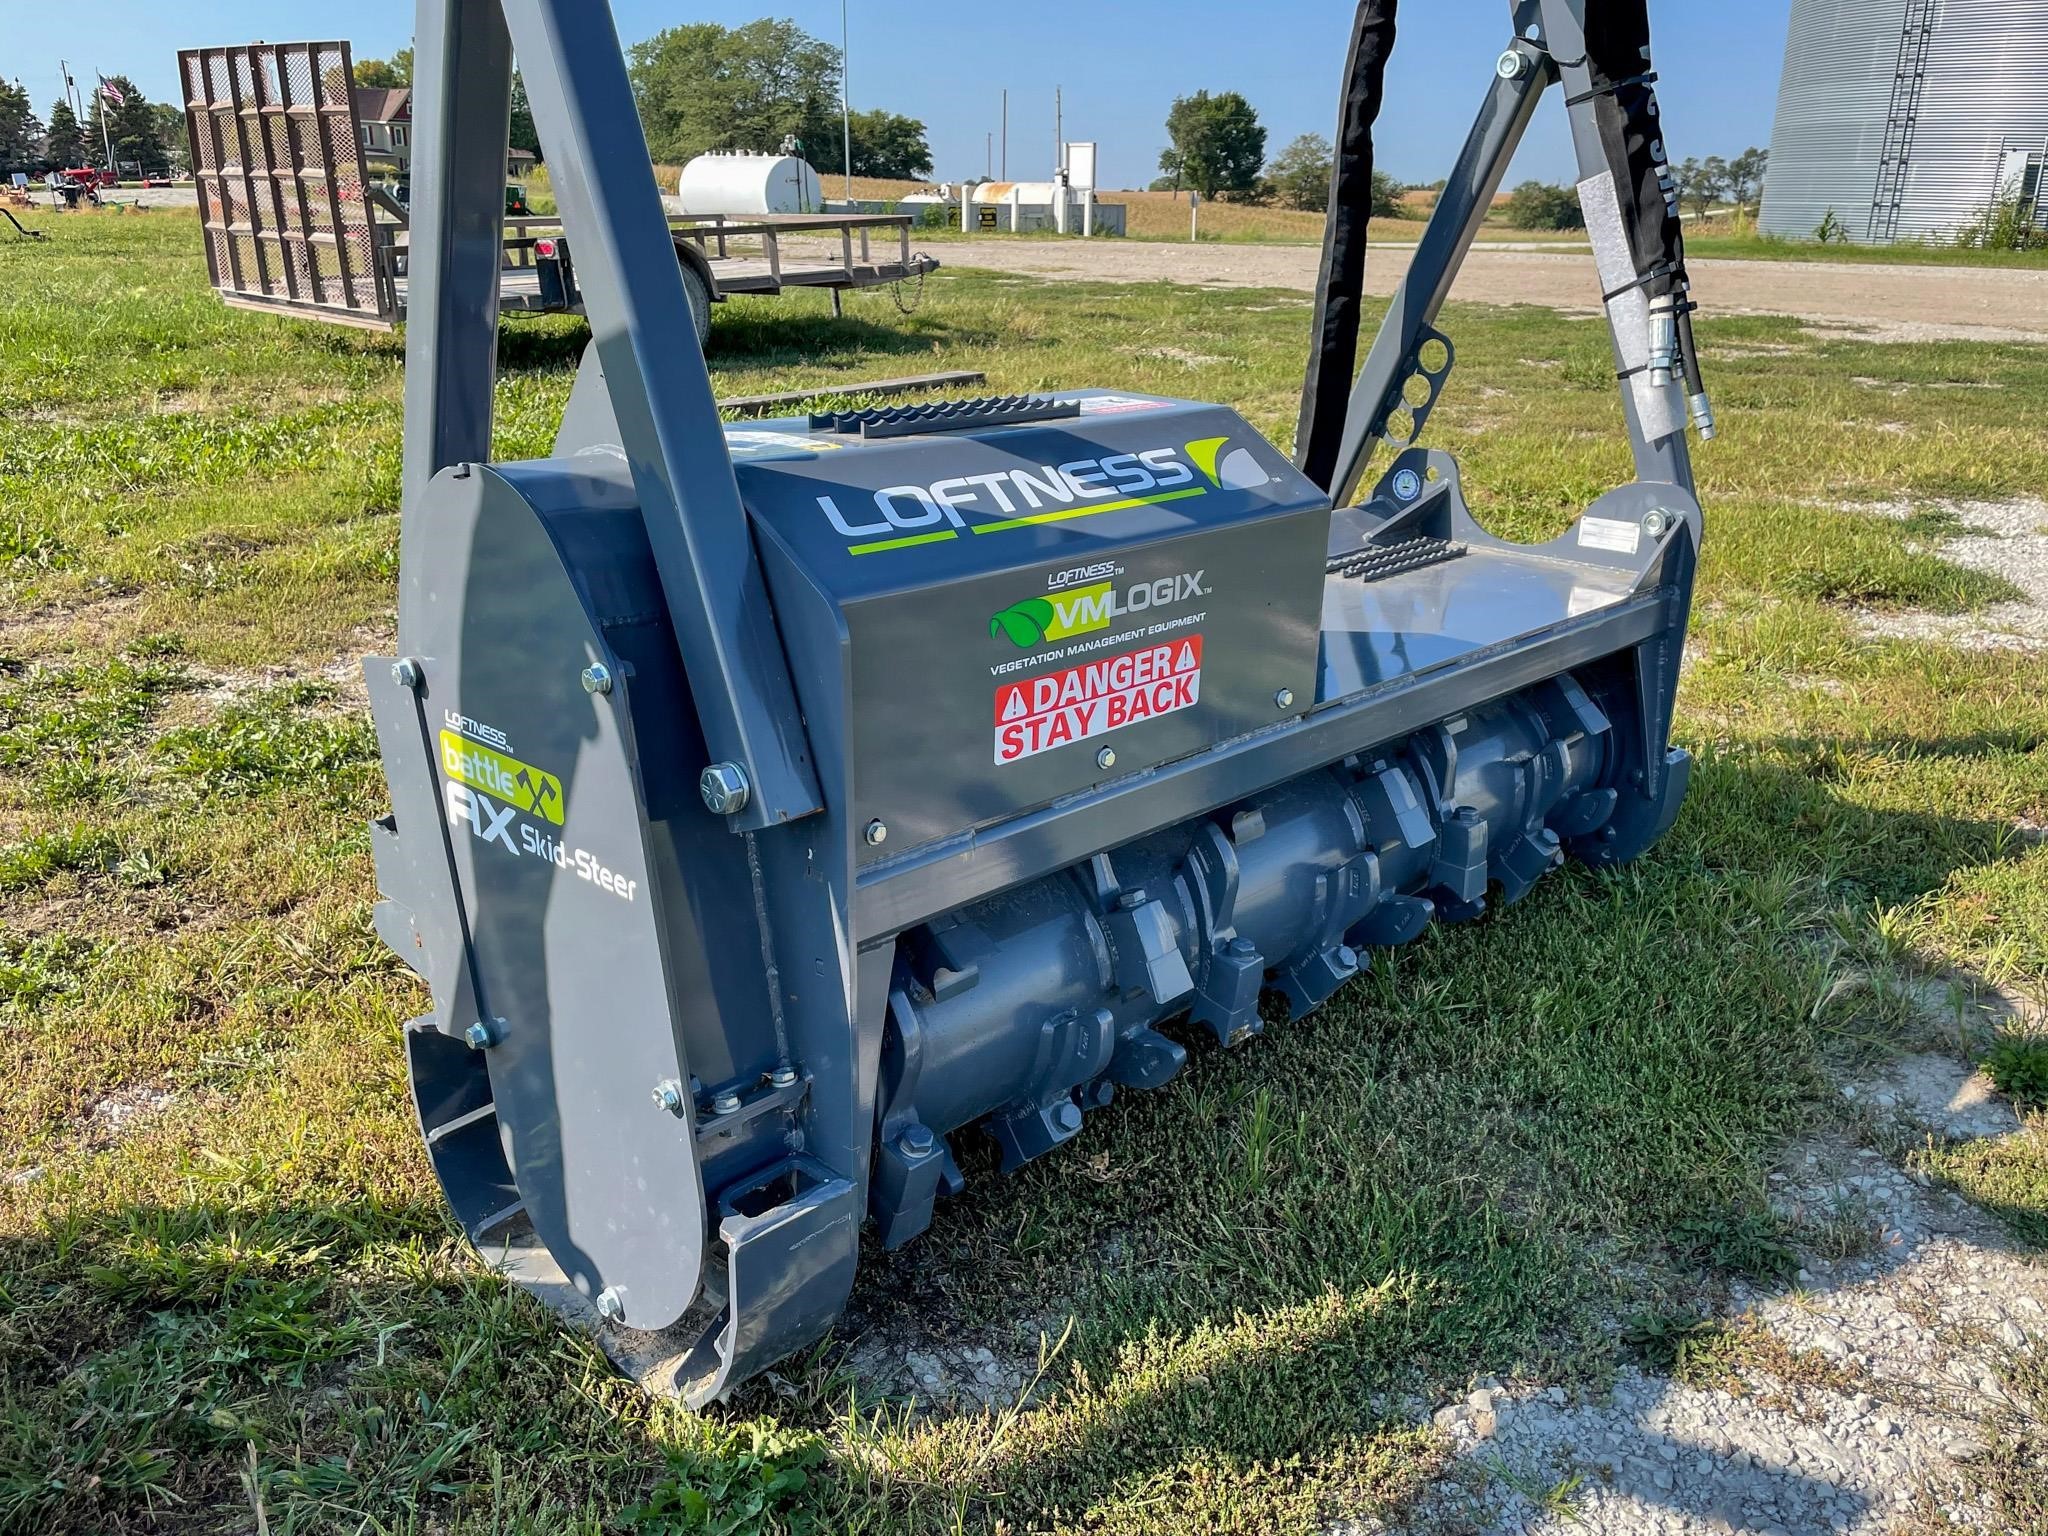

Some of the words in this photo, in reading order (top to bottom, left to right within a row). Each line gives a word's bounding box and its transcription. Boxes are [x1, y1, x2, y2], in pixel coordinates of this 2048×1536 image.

[816, 447, 1193, 537] LOFTNESS
[1048, 561, 1116, 586] LOFTNESS
[1055, 570, 1205, 630] VMLOGIX
[990, 648, 1064, 676] VEGETATION
[1067, 627, 1146, 655] MANAGEMENT
[1148, 612, 1207, 636] EQUIPMENT
[1033, 646, 1172, 714] DANGER
[445, 709, 507, 745] LOFTNESS
[1001, 702, 1097, 760] STAY
[1107, 674, 1195, 729] BACK
[443, 738, 515, 799] battle
[446, 780, 521, 856] AX
[520, 823, 637, 901] Skid-Steer
